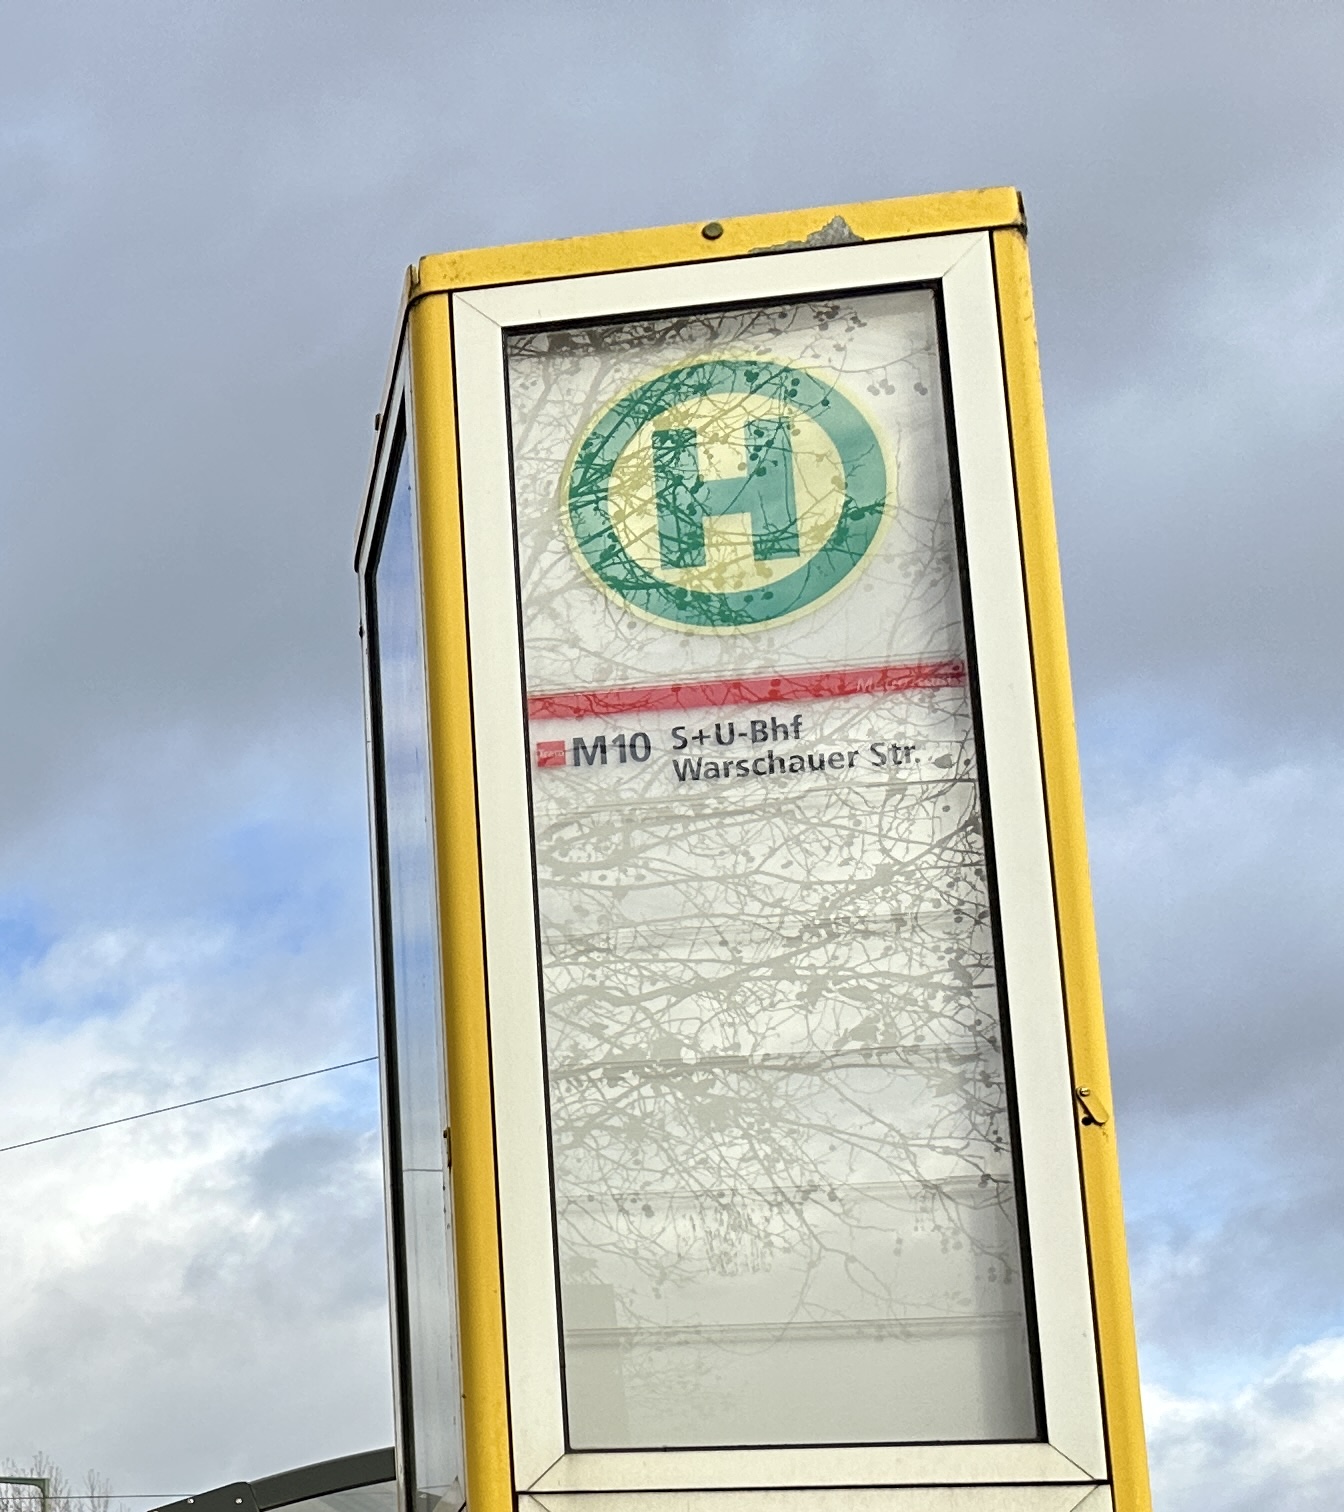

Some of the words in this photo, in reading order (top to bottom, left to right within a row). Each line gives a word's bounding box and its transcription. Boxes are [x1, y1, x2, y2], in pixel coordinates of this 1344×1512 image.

[652, 416, 801, 570] H
[572, 731, 652, 767] M10
[670, 714, 803, 750] S+U-Bhf
[672, 749, 860, 782] Warschauer
[869, 741, 920, 767] Str.
